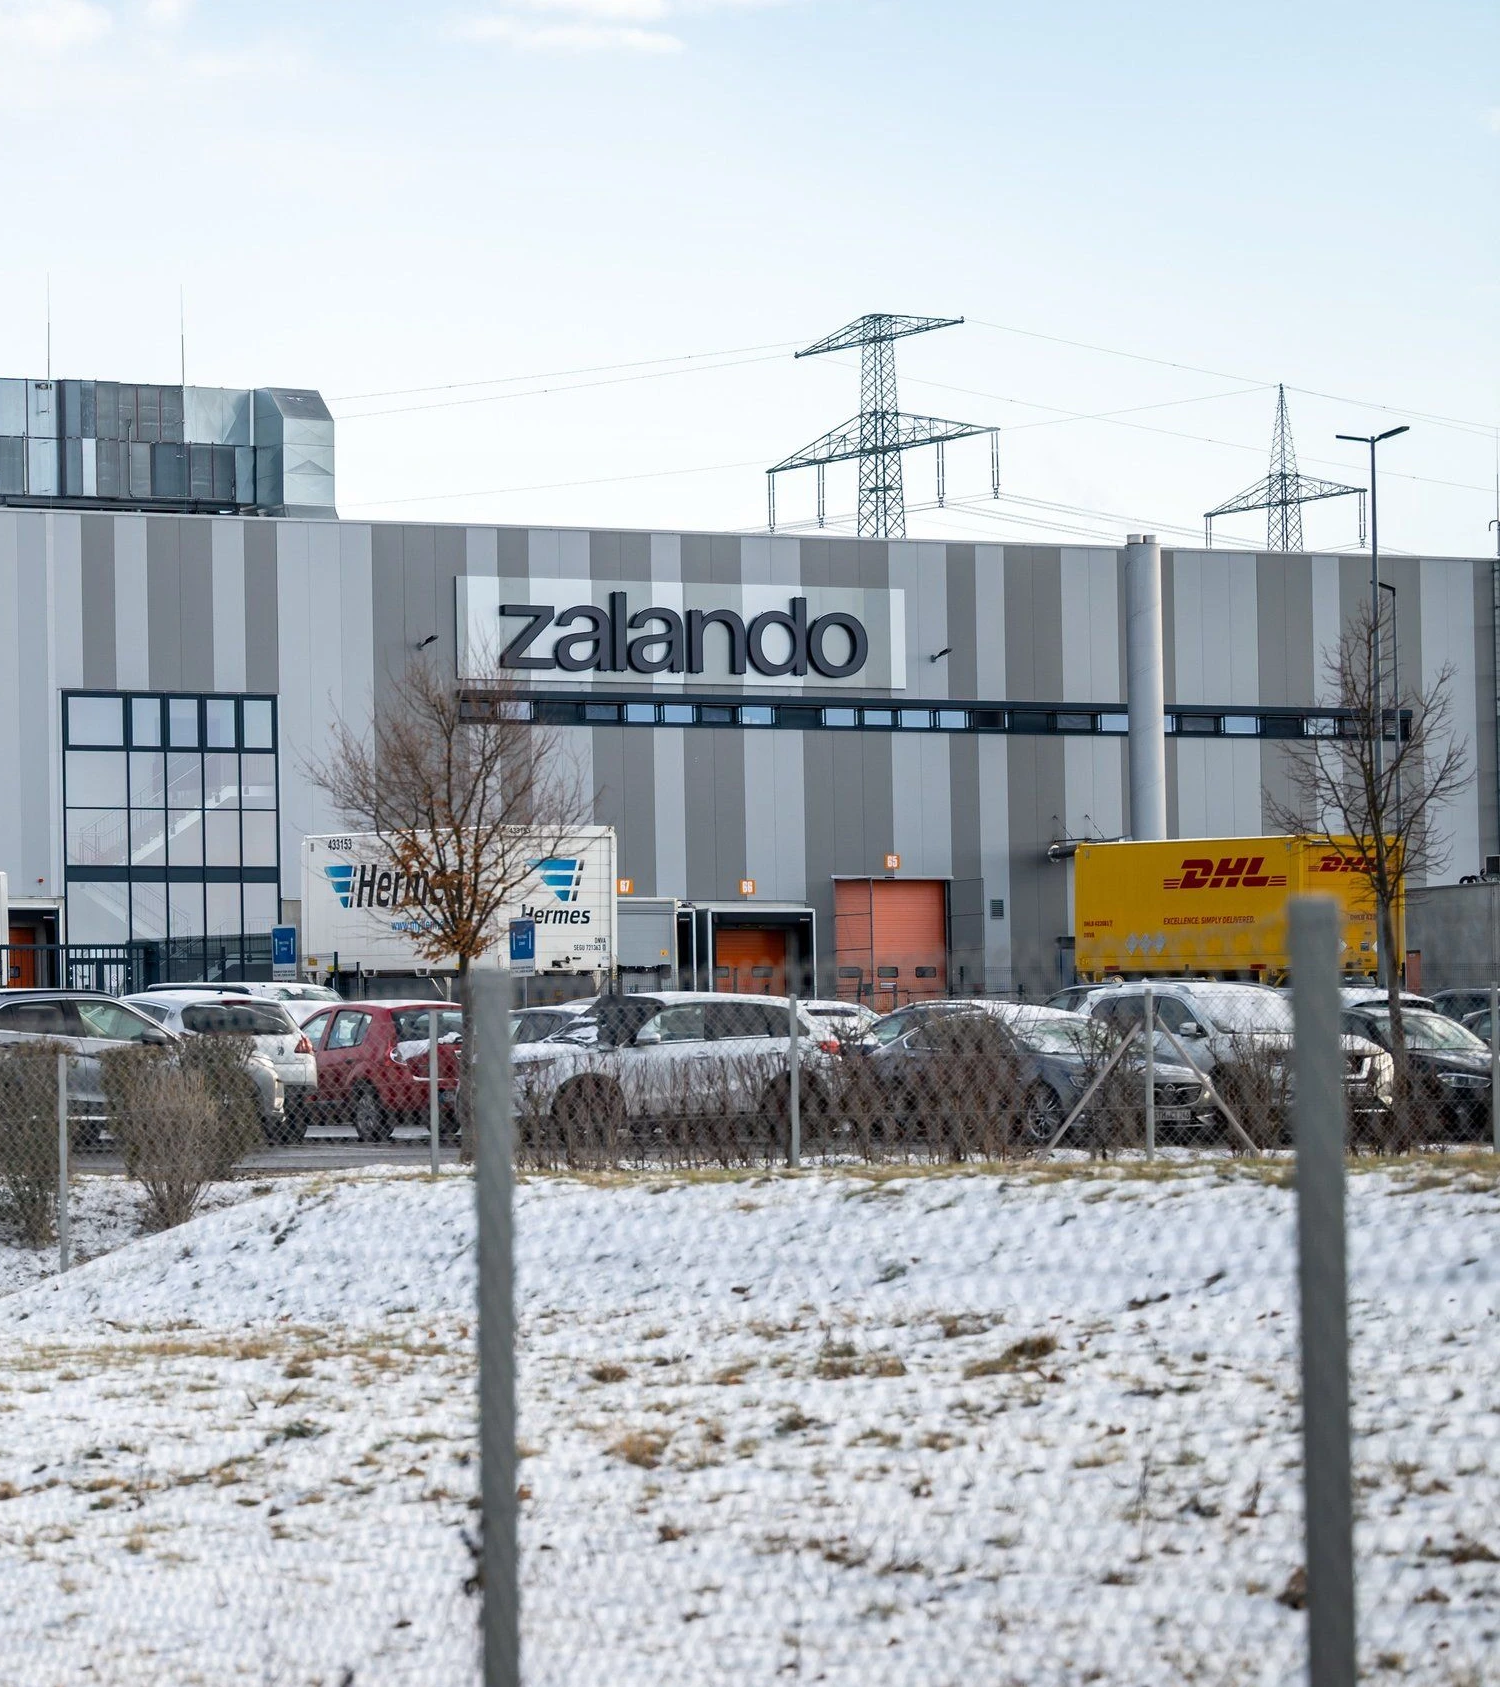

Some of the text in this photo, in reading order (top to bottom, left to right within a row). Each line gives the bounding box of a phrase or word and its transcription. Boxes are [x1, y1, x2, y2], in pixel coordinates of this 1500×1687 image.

[500, 591, 868, 677] zalando
[328, 838, 352, 851] 433153
[887, 855, 898, 868] 65
[1180, 857, 1270, 889] DHL
[620, 880, 630, 892] 67
[742, 881, 753, 893] 66
[521, 903, 591, 924] Hermes
[1201, 916, 1222, 925] SIMPLY
